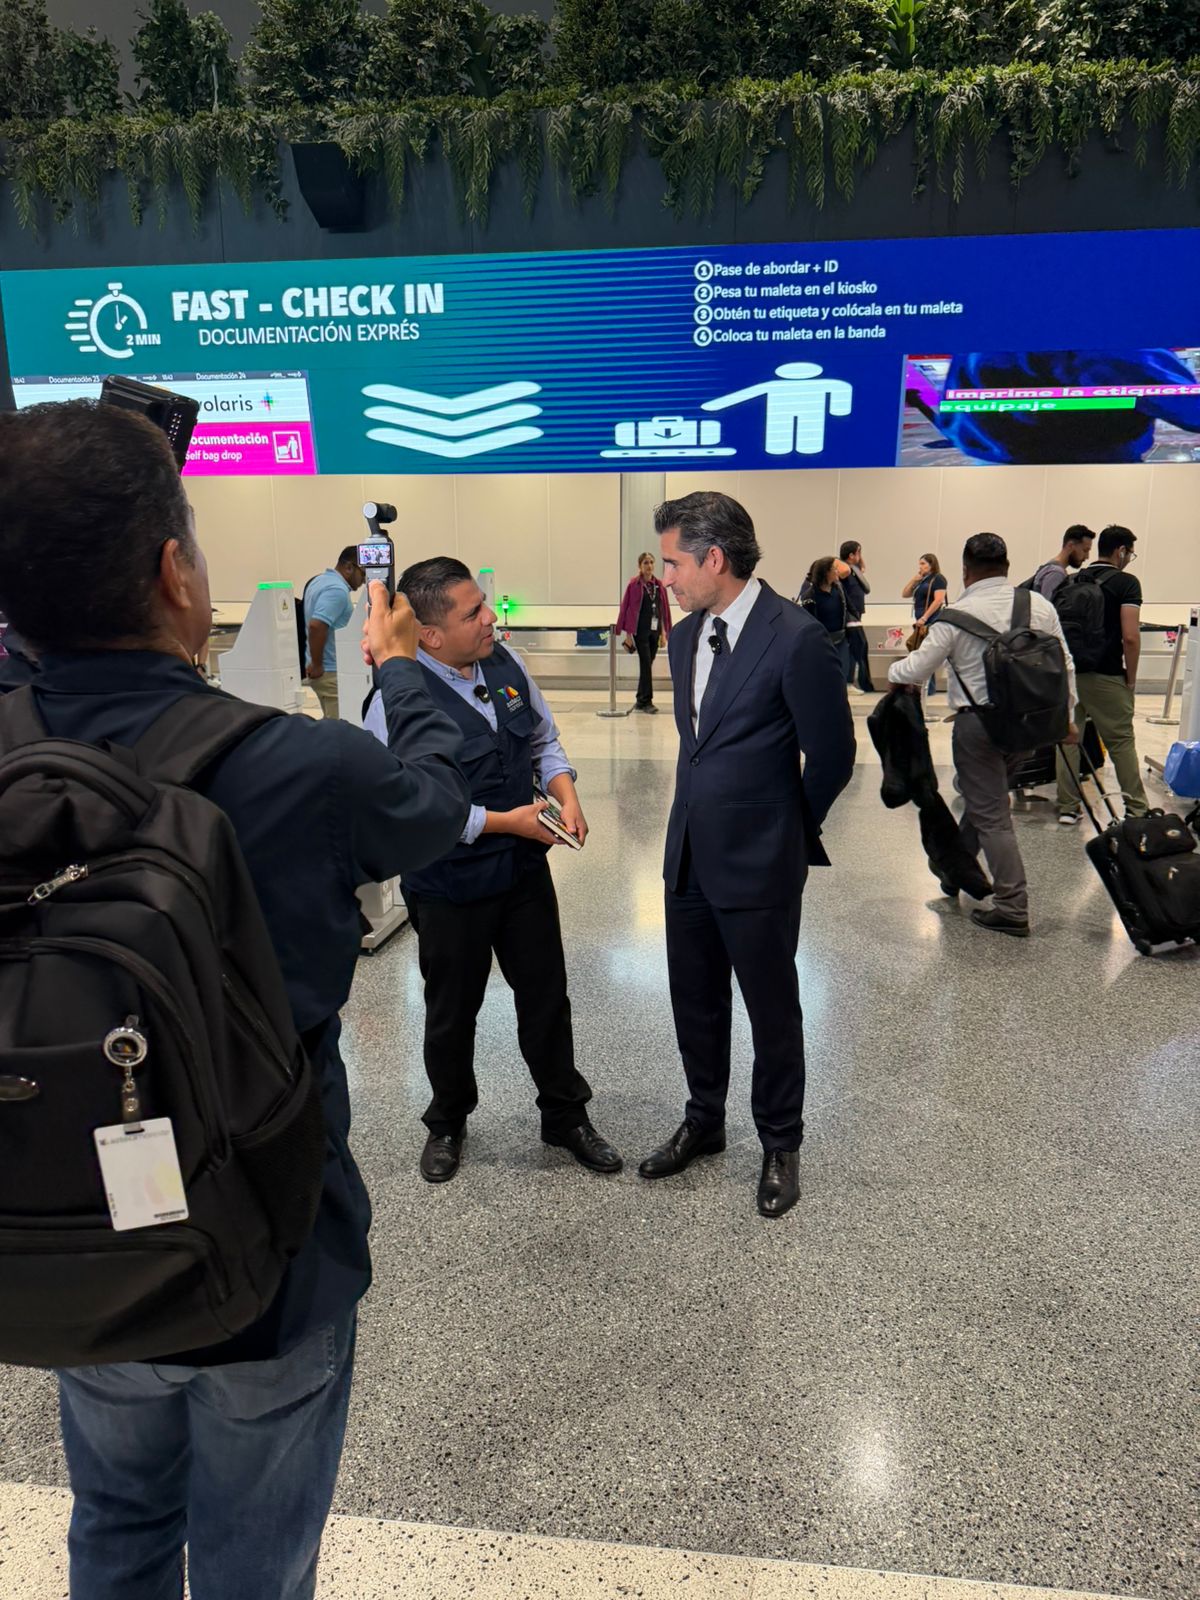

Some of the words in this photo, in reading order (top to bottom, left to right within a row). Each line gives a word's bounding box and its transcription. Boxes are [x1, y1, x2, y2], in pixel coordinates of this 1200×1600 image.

[714, 264, 742, 277] Pase
[745, 263, 760, 275] de
[763, 262, 810, 275] abordar
[812, 264, 822, 272] +
[824, 260, 838, 273] ID
[714, 286, 741, 298] Pesa
[744, 286, 758, 297] tu
[760, 284, 802, 297] maleta
[804, 285, 820, 295] en
[822, 282, 834, 295] el
[837, 281, 878, 294] kiosko
[171, 289, 249, 322] FAST
[259, 303, 273, 312] -
[281, 286, 396, 319] CHECK
[404, 283, 445, 314] IN
[714, 307, 751, 320] Obtén
[753, 308, 767, 319] tu
[769, 306, 819, 321] etiqueta
[821, 308, 830, 320] y
[832, 304, 882, 317] colócala
[885, 305, 900, 315] en
[903, 304, 918, 315] tu
[920, 301, 963, 314] maleta
[126, 334, 134, 346] 2
[135, 333, 161, 345] MIN
[199, 321, 353, 346] DOCUMENTACIÓN
[357, 319, 420, 342] EXPRÉS
[713, 329, 753, 342] Coloca
[756, 331, 770, 341] tu
[772, 328, 813, 341] maleta
[815, 329, 831, 339] en
[834, 327, 845, 339] la
[848, 326, 886, 338] banda
[49, 376, 92, 384] Documentación
[196, 372, 238, 380] Documentación
[948, 388, 1054, 400] Imprime
[1062, 388, 1086, 396] la
[1092, 386, 1200, 396] etiqueta
[941, 401, 1057, 412] equipaje
[191, 432, 268, 445] ocumentación
[185, 450, 201, 460] Self
[203, 450, 219, 462] bag
[221, 450, 242, 462] drop
